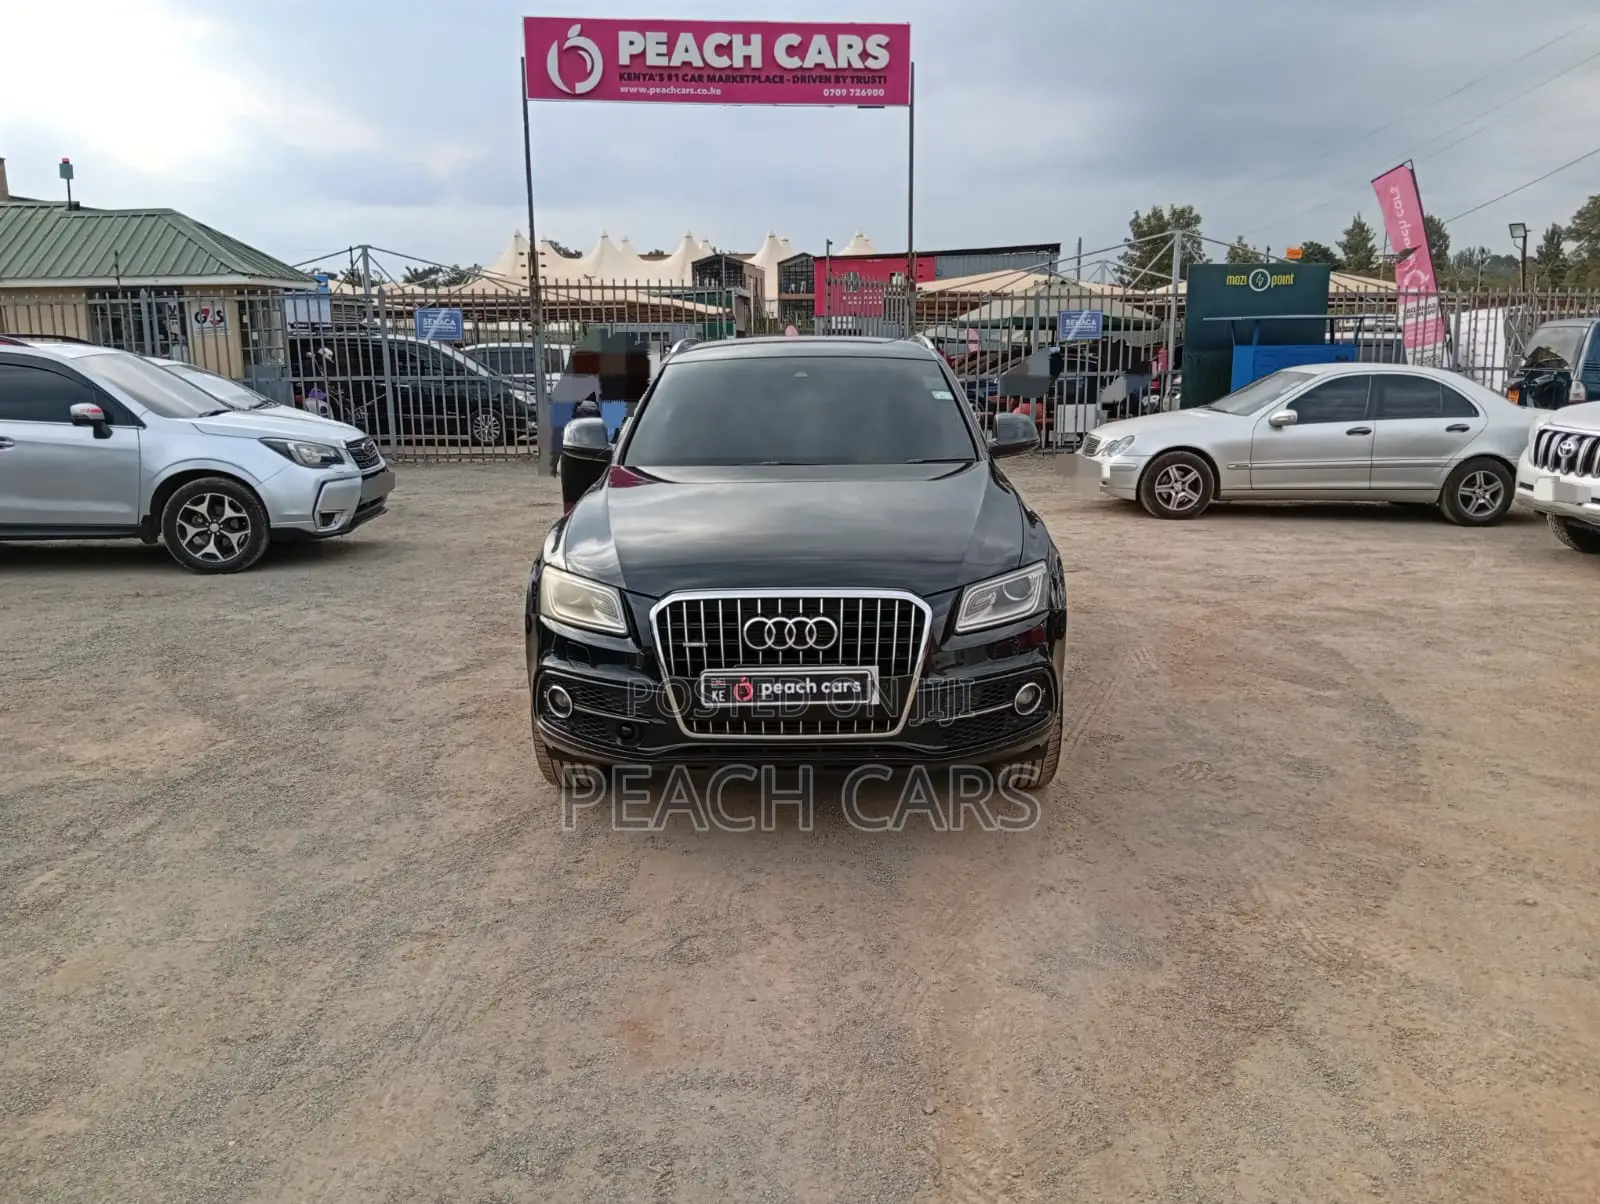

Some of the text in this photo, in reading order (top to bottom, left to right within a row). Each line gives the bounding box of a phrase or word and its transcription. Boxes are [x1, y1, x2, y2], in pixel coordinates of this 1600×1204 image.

[617, 31, 891, 70] PEACH CARS
[619, 72, 665, 82] KENYA'S
[681, 74, 704, 83] CAR
[706, 74, 785, 84] MARKETPLACE
[792, 75, 832, 84] DRIVEN
[834, 75, 850, 84] BY
[619, 85, 722, 96] www.peachcars.co.ke
[823, 88, 885, 97] 0709 726900
[761, 677, 861, 700] peach cars
[710, 689, 726, 702] KE
